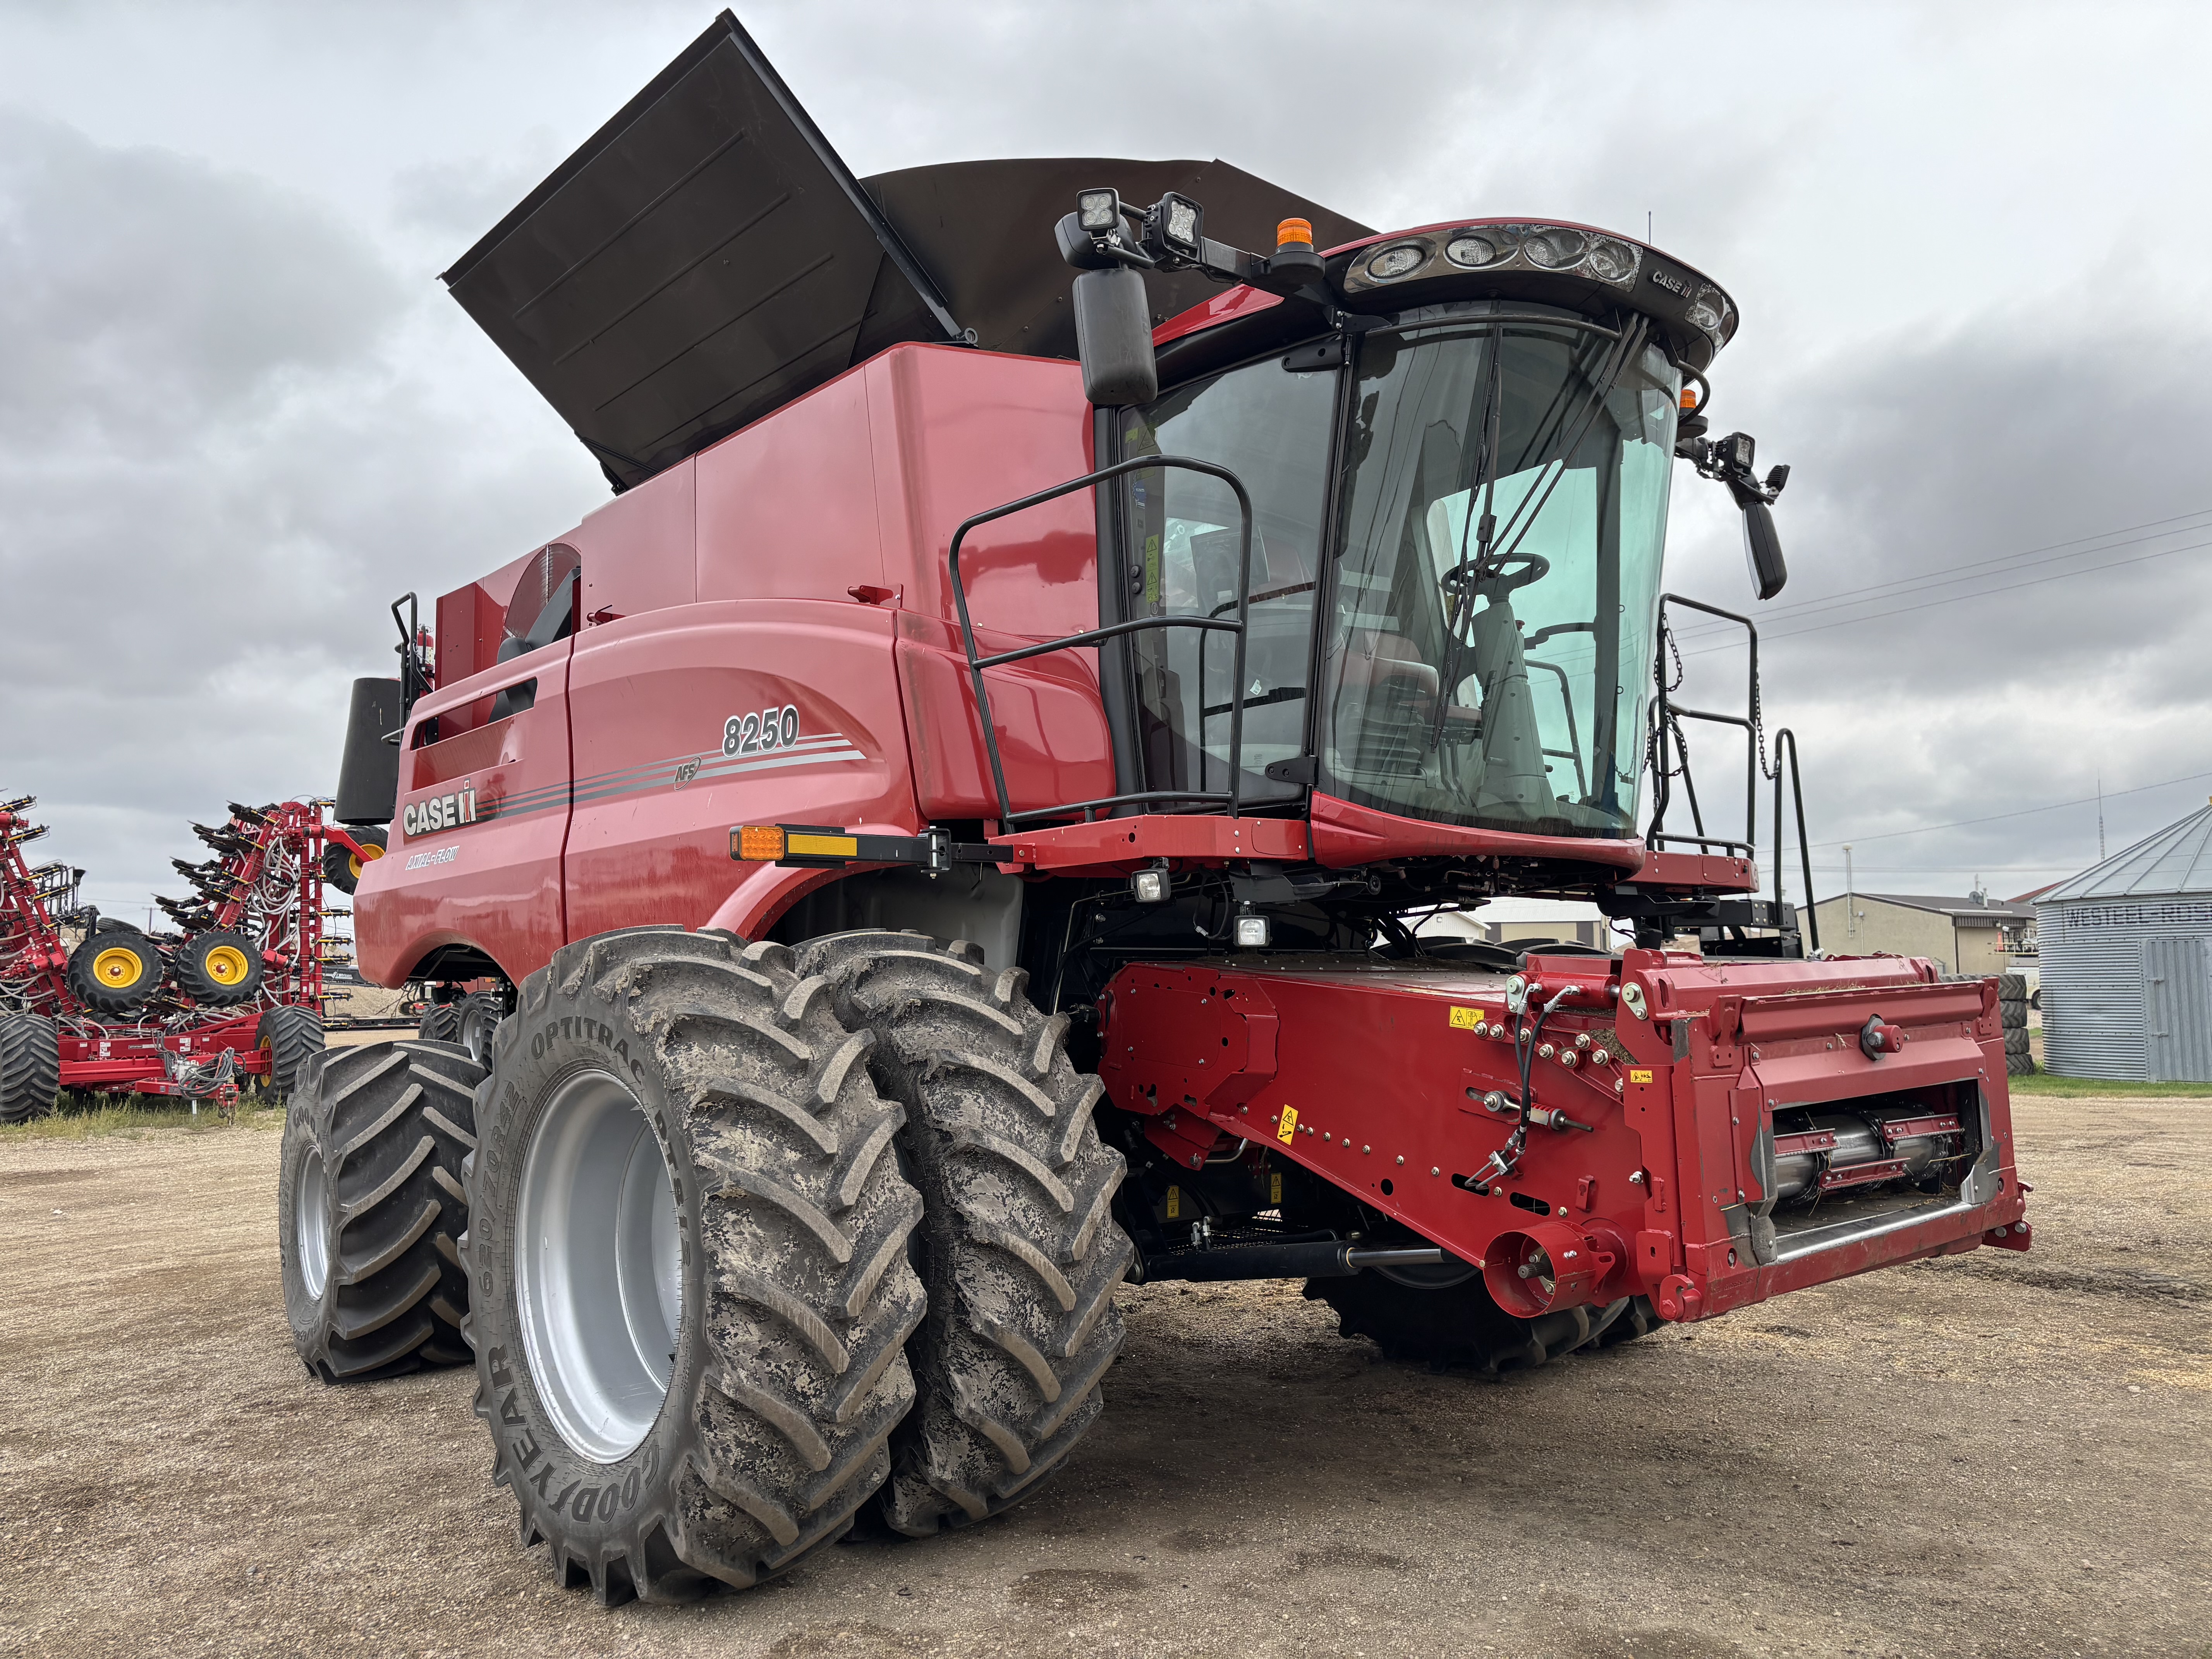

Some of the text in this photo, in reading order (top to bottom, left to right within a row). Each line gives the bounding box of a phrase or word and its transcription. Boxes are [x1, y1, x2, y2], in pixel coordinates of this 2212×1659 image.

[1653, 270, 1683, 293] CASE
[722, 704, 800, 758] 8250
[674, 763, 696, 782] AFS
[403, 794, 456, 836] CASE
[405, 845, 460, 871] AXIAL-FLOW
[2067, 901, 2212, 927] WESTEEL-ROS
[531, 1015, 645, 1084] OPTITRAC
[479, 1081, 520, 1297] 620/70R42
[488, 1343, 660, 1525] GOODYEAR
